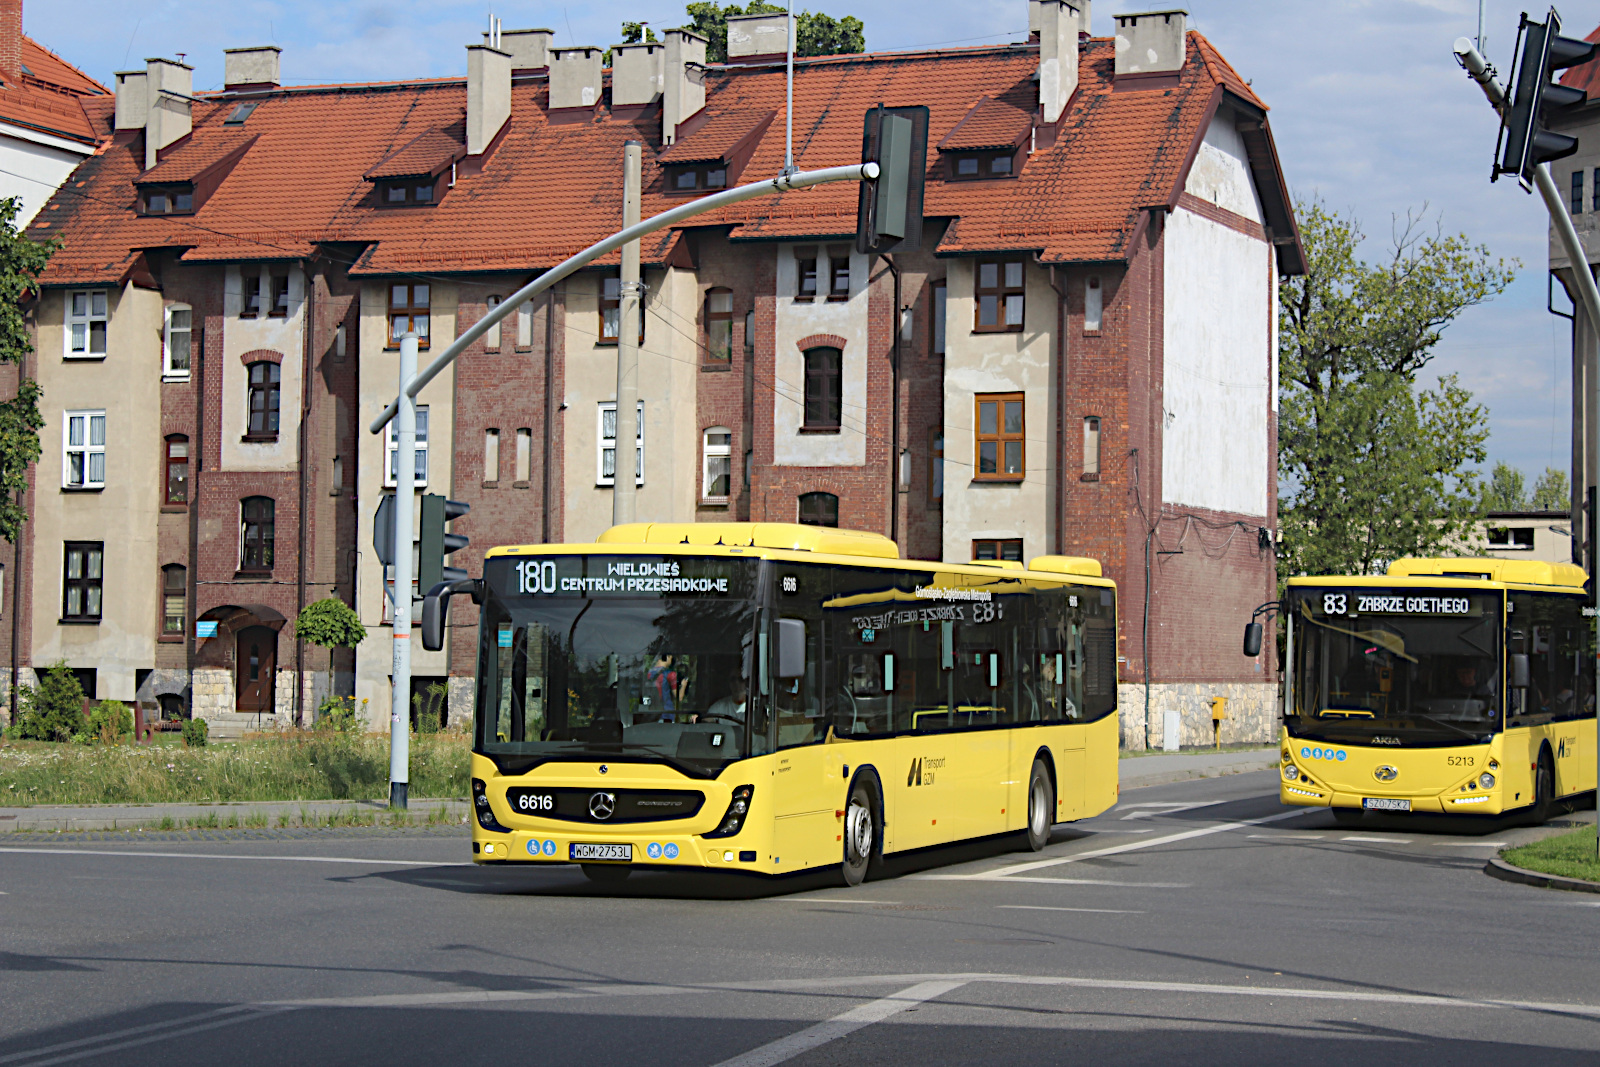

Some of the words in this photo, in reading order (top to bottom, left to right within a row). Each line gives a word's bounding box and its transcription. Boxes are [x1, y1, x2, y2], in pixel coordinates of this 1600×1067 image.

[515, 560, 556, 593] 180
[607, 561, 680, 577] WIELOWIEŚ
[561, 578, 624, 592] CENTRUM
[627, 578, 728, 593] PRZESIADKOWE
[1323, 594, 1347, 614] 83
[1358, 596, 1404, 613] ZABRZE
[1406, 597, 1469, 614] GOETHEGO
[923, 756, 946, 771] Transport
[1447, 756, 1475, 767] 5213
[518, 794, 553, 810] 6616
[575, 845, 596, 857] WGM
[598, 845, 630, 858] 2753L
